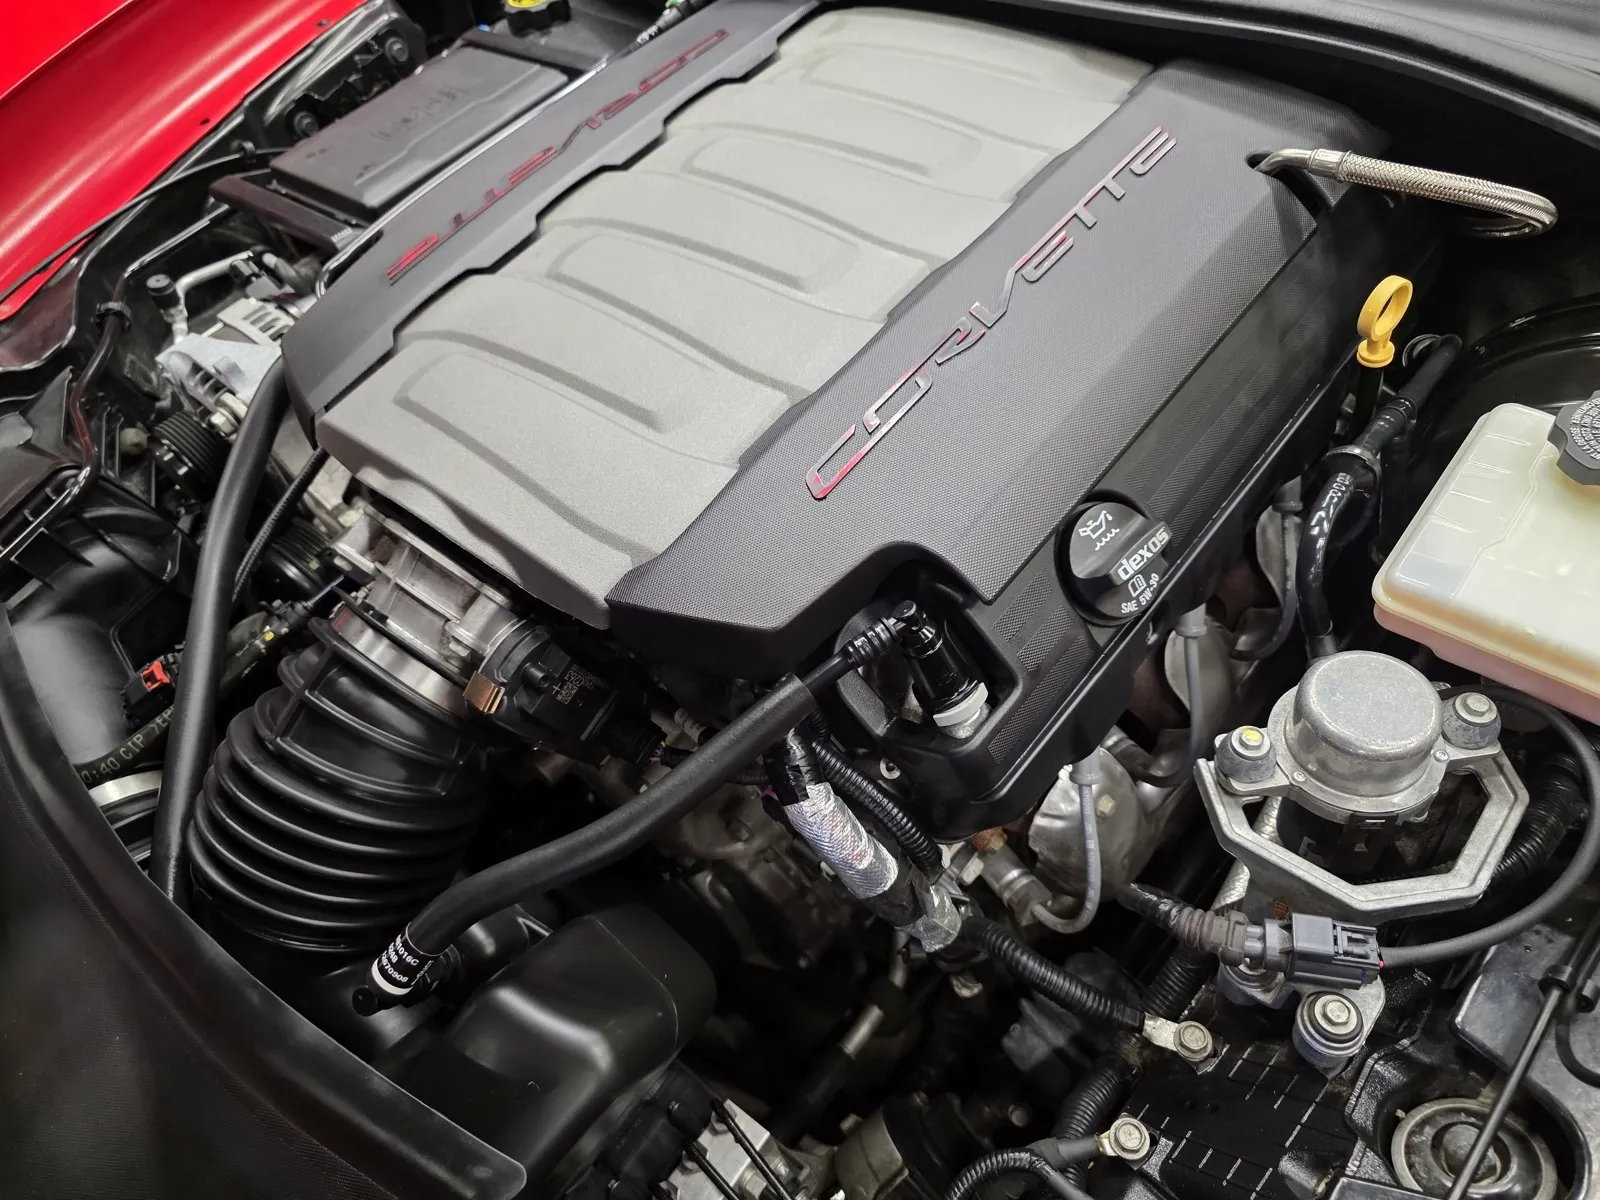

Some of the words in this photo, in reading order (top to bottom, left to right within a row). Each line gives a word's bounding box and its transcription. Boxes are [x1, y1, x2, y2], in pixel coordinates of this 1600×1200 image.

[806, 125, 1177, 500] CORVETTE
[1117, 527, 1169, 580] dexos
[1121, 600, 1138, 613] SAE
[1139, 573, 1160, 606] 5W-30
